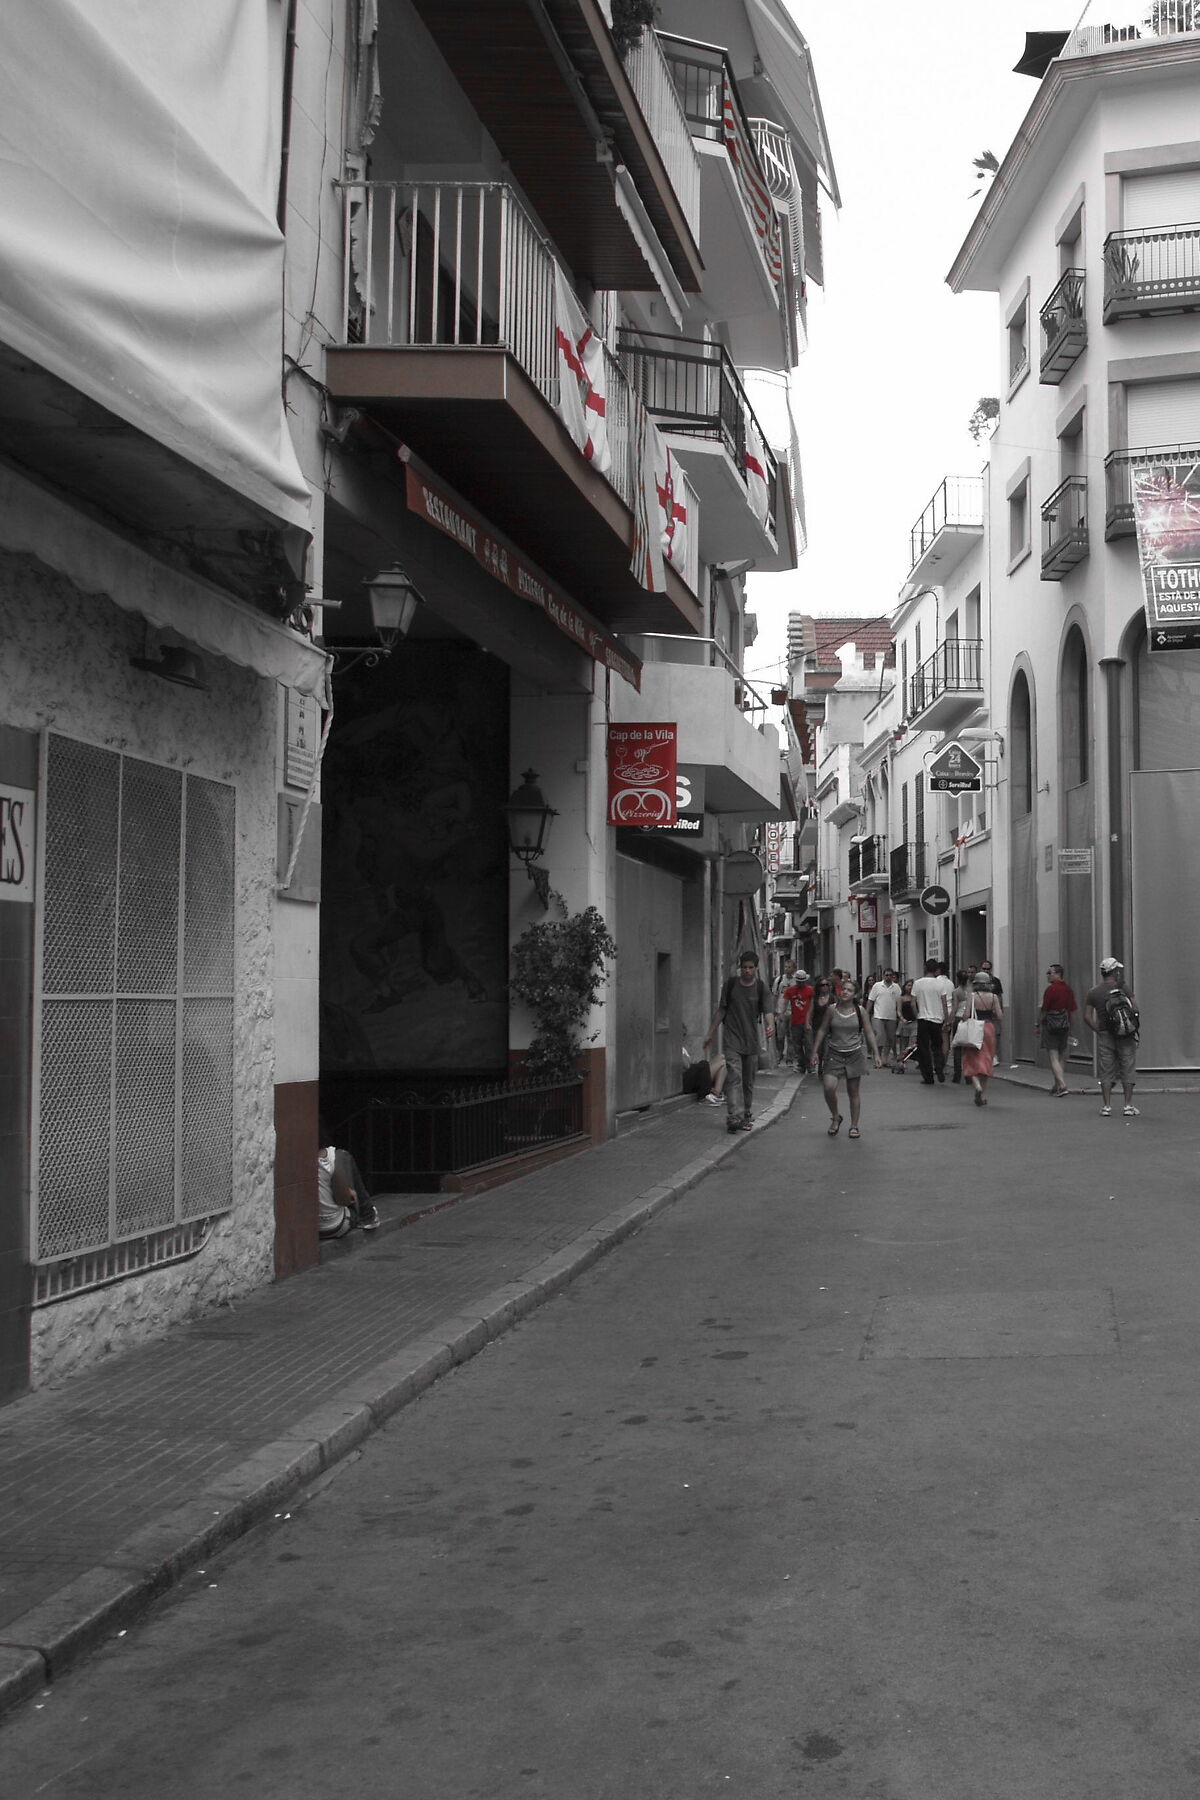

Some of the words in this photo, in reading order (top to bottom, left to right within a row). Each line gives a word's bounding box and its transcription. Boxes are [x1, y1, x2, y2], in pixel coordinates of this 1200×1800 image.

[1184, 591, 1196, 600] DE
[610, 730, 628, 742] Cap
[630, 730, 641, 740] de
[644, 730, 653, 740] la
[655, 730, 674, 740] Vila
[622, 810, 660, 818] Pizzeria
